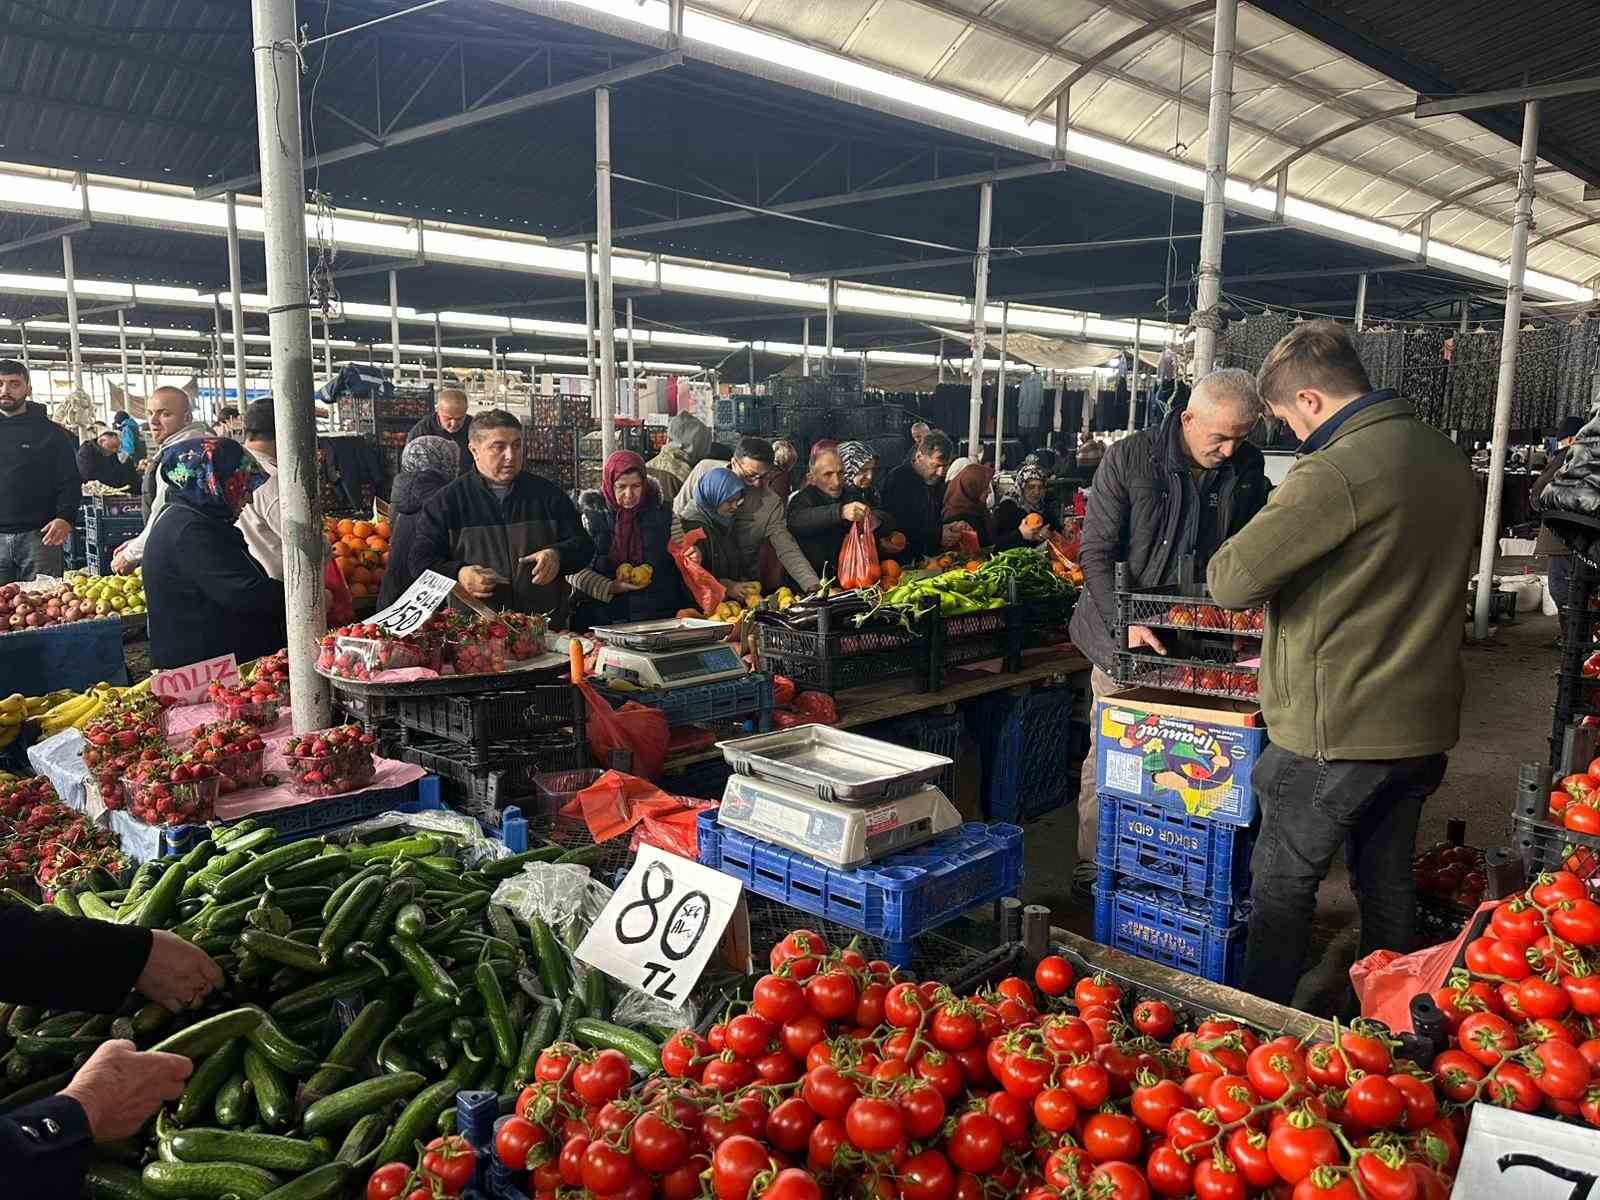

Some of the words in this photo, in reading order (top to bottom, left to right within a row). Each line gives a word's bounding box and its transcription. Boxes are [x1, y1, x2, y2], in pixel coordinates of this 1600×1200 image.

[615, 860, 711, 961] 80
[669, 918, 692, 935] AL
[641, 961, 679, 1002] TL
